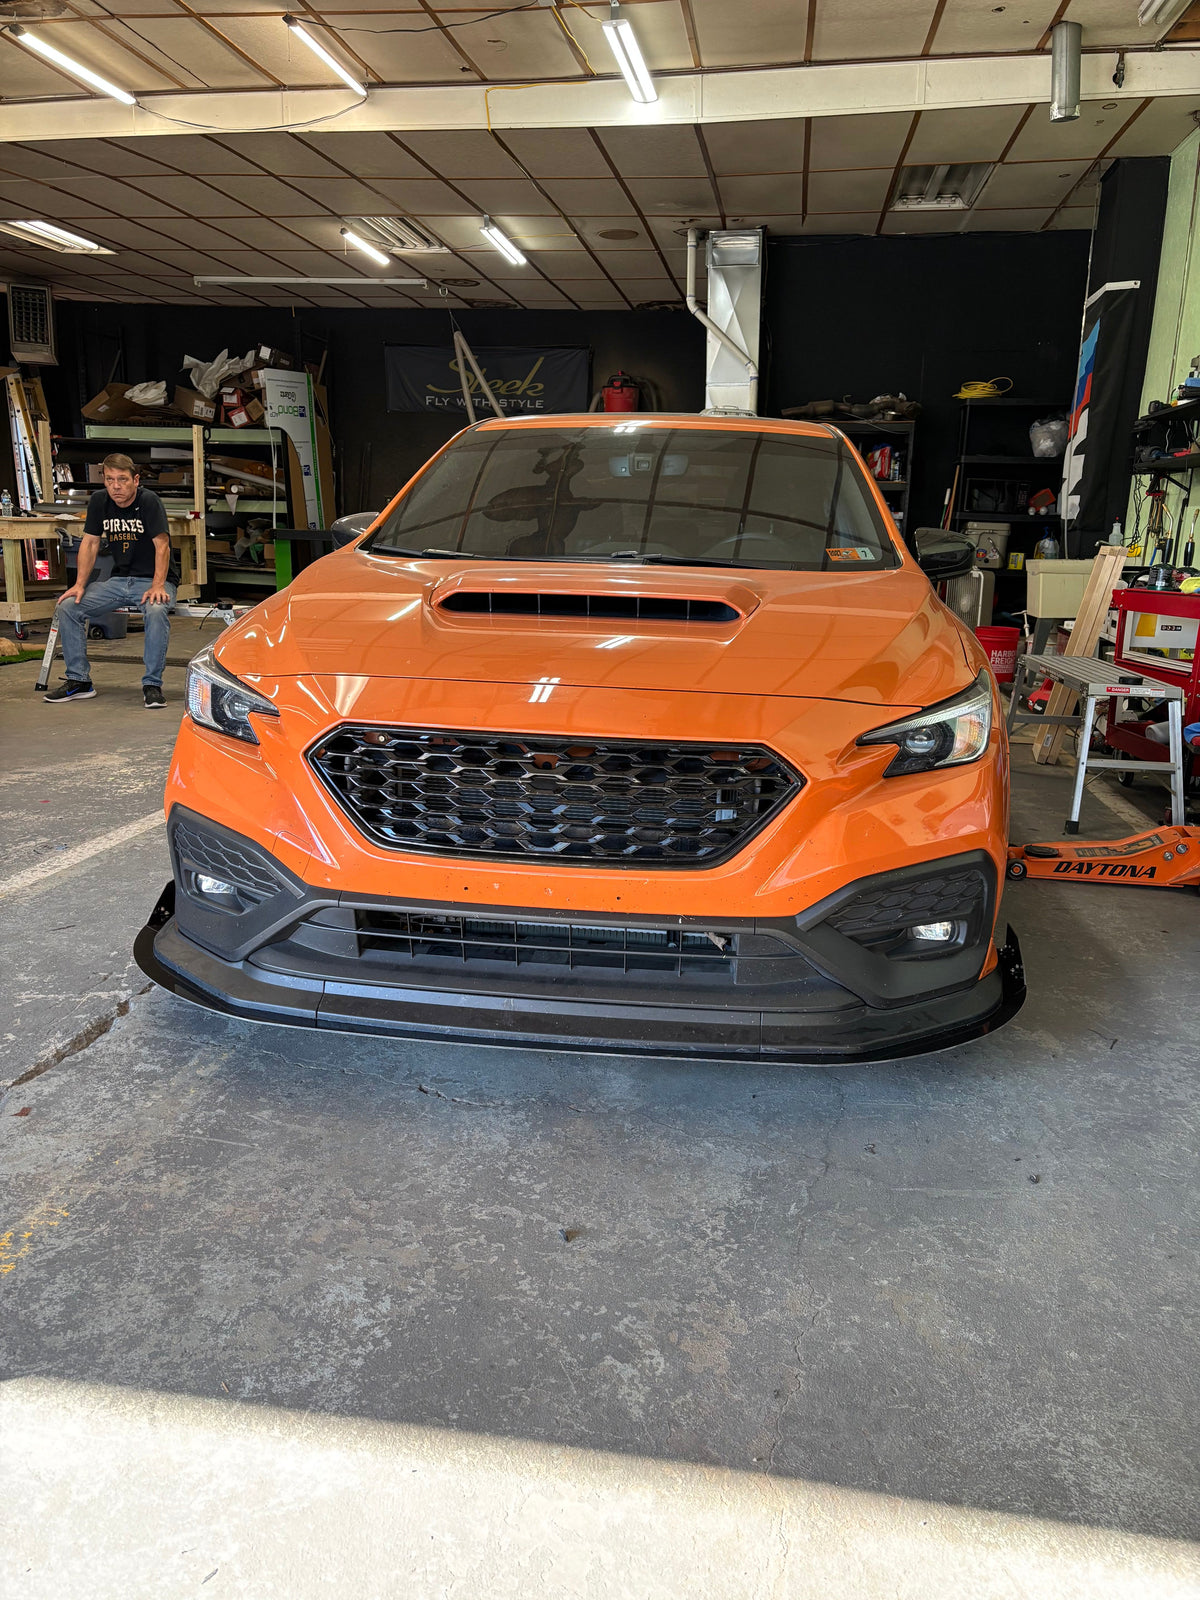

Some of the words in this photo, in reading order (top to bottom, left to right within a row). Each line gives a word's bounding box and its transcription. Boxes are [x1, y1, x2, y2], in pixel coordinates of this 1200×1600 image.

[425, 395, 450, 406] FLY
[456, 398, 491, 407] WTH
[499, 398, 544, 409] STYLE
[122, 541, 130, 553] P
[1053, 861, 1157, 879] DAYTONA
